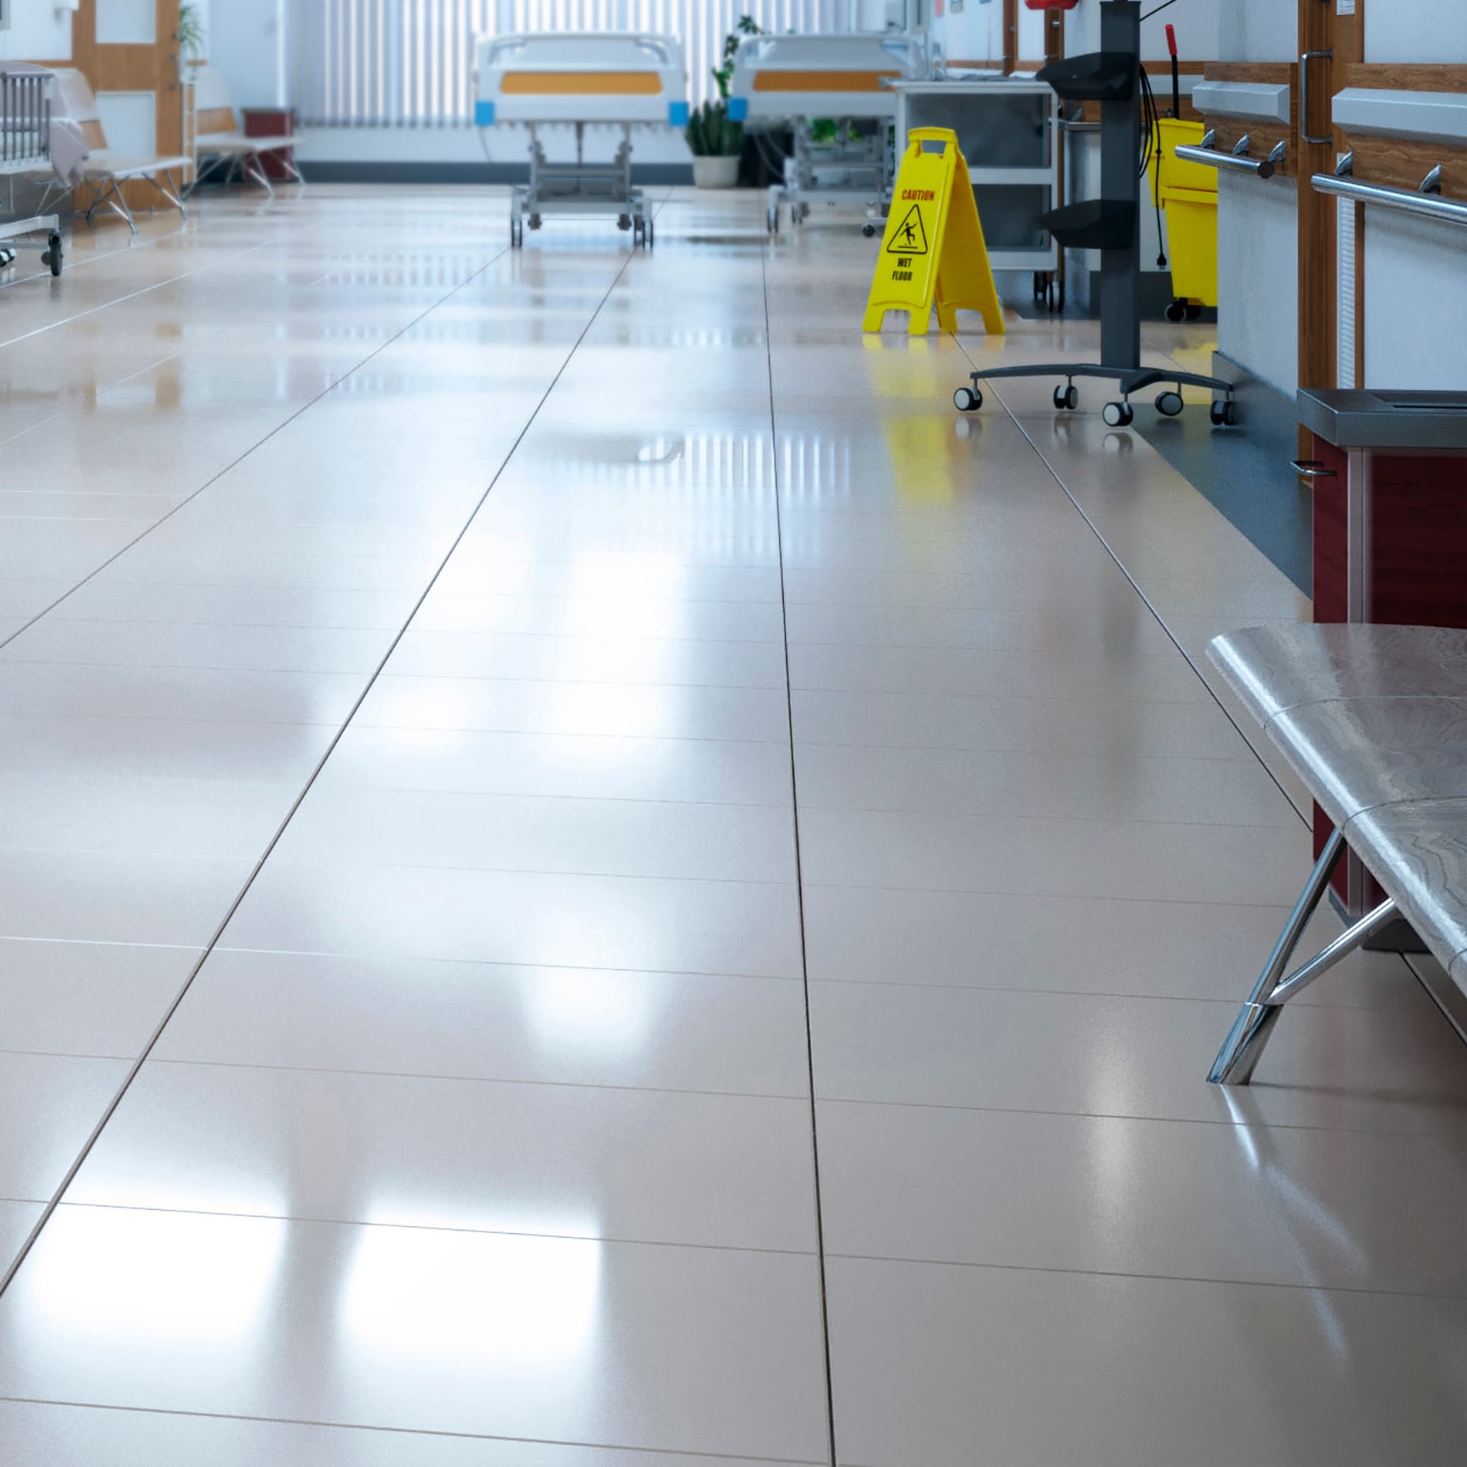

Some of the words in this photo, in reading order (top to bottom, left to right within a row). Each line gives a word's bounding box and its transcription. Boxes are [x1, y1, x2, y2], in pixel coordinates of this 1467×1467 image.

[901, 189, 935, 201] CAUTION
[897, 257, 912, 268] WET
[891, 270, 913, 281] FLOOR
